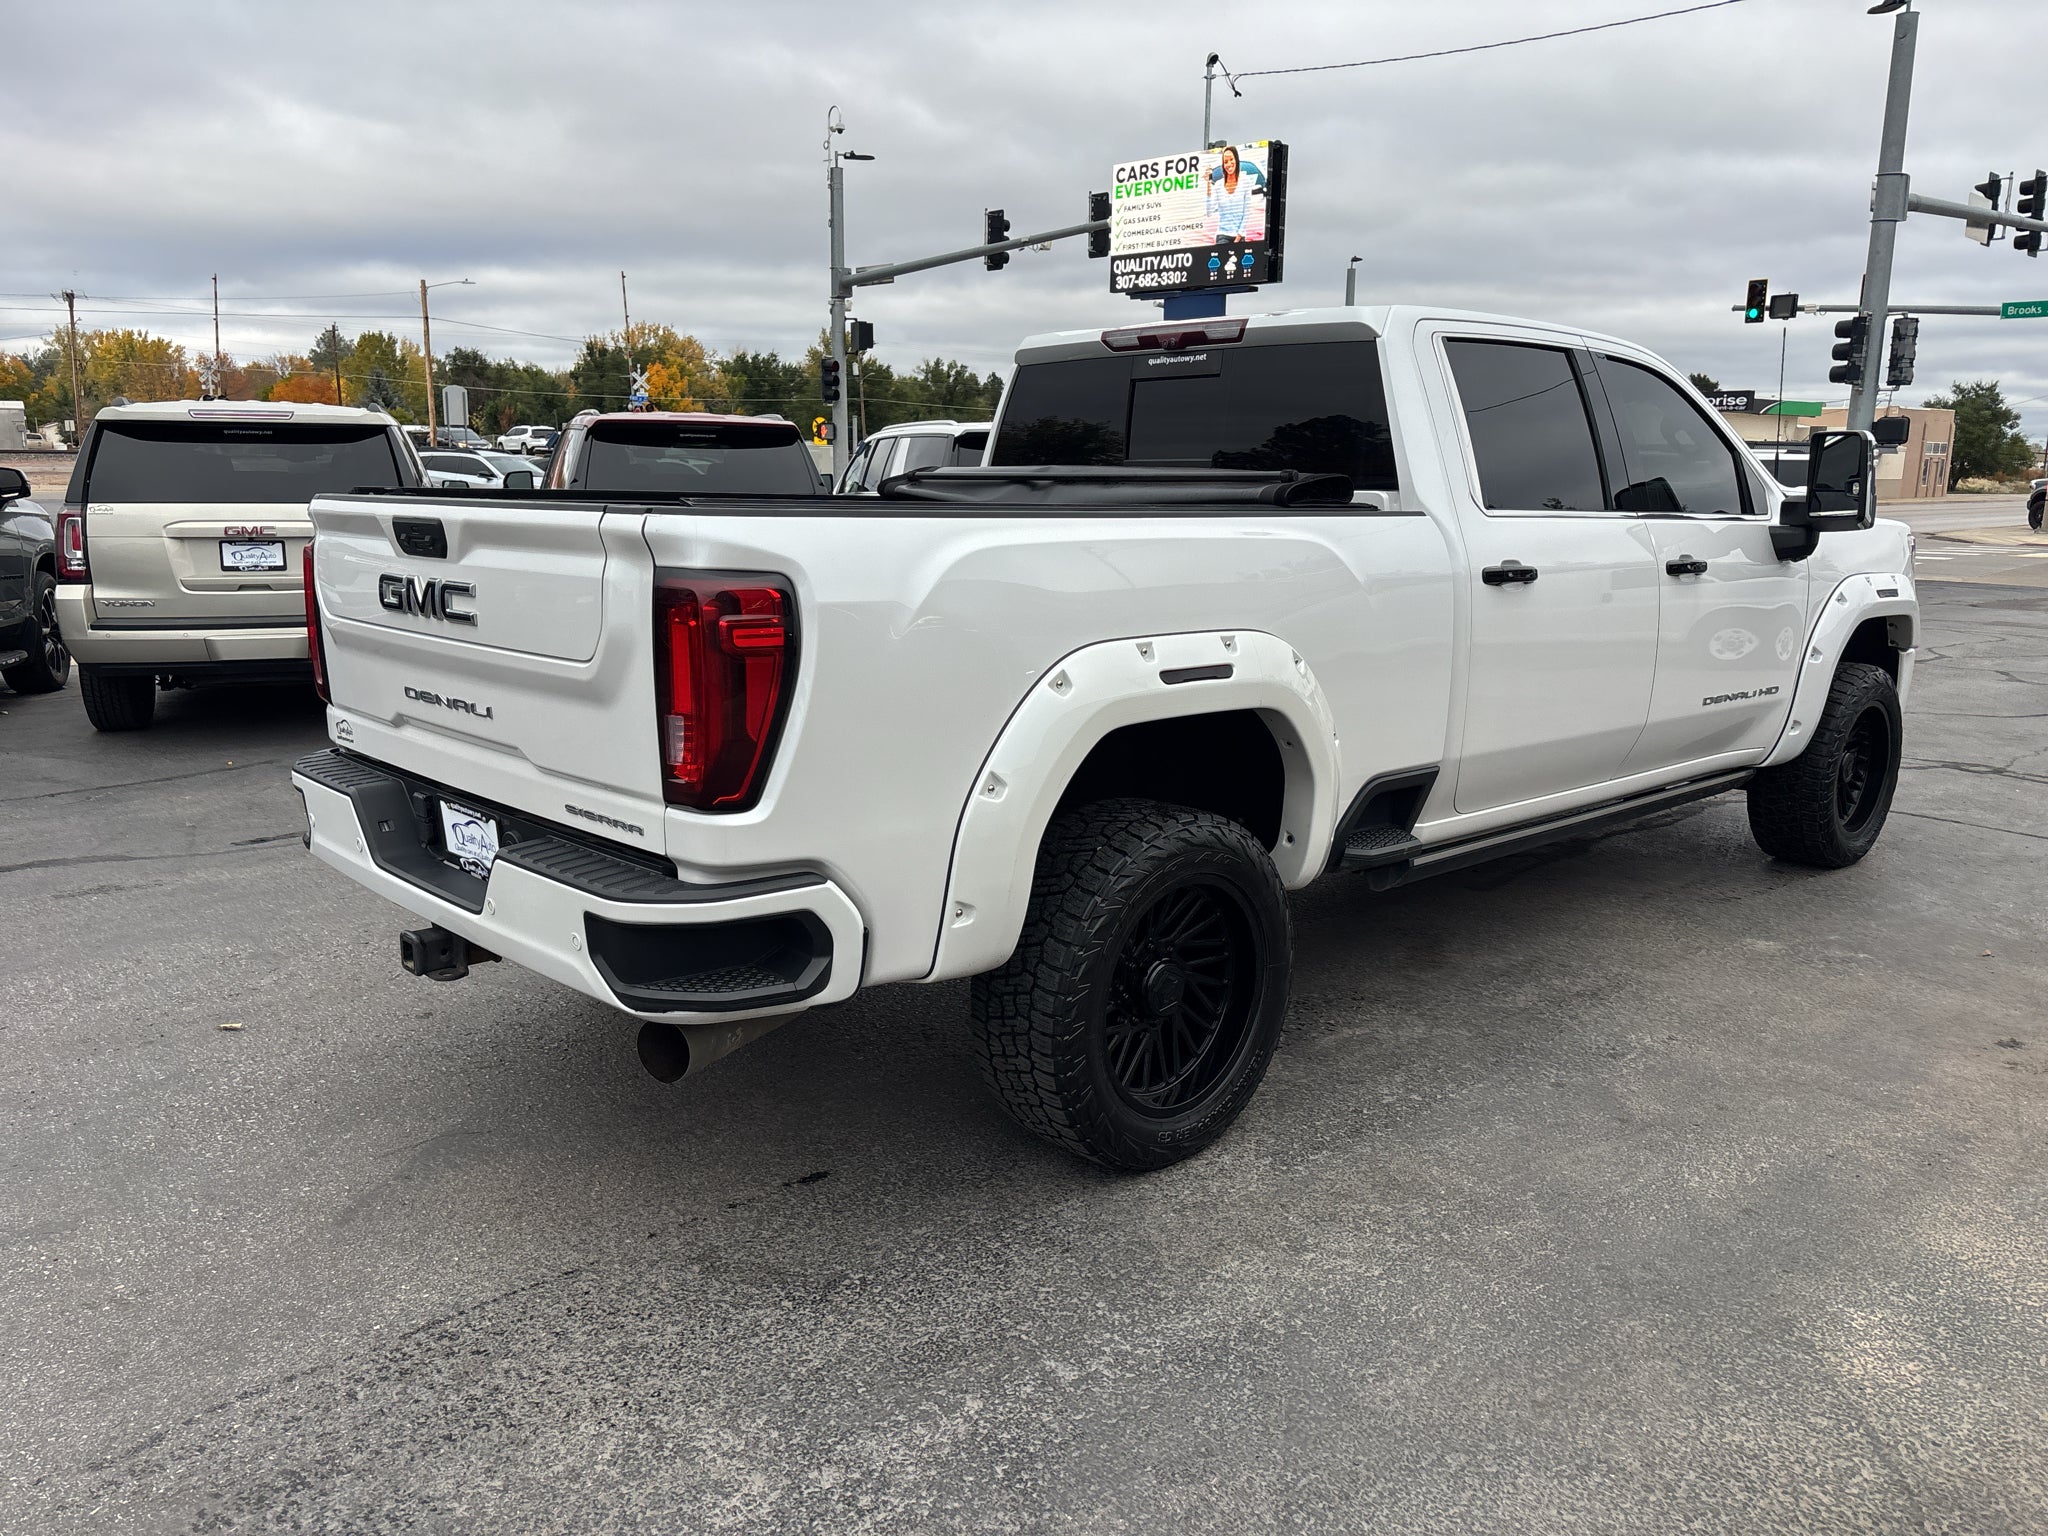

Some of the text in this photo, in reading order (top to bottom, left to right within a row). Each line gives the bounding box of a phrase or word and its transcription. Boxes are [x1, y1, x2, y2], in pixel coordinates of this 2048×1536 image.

[1116, 156, 1200, 184] CARS FOR
[1115, 174, 1199, 199] EVERYONE!
[1123, 203, 1145, 213] FAMILY
[1123, 214, 1161, 226] GAS SAVERS
[1122, 223, 1204, 238] COMMERCIAL CUSTOMERS
[1156, 238, 1182, 247] BUYERS
[1113, 252, 1193, 274] QUALITY AUTO
[1115, 271, 1188, 289] 307-682-3302
[2007, 305, 2042, 315] Brooks
[1148, 353, 1207, 366] qualityautowy.net
[224, 526, 277, 537] GMC
[100, 600, 156, 608] YUKON
[378, 572, 479, 627] GMC
[404, 686, 494, 720] DENALI
[1702, 686, 1780, 706] DENALI HD
[564, 804, 645, 837] SIERRA
